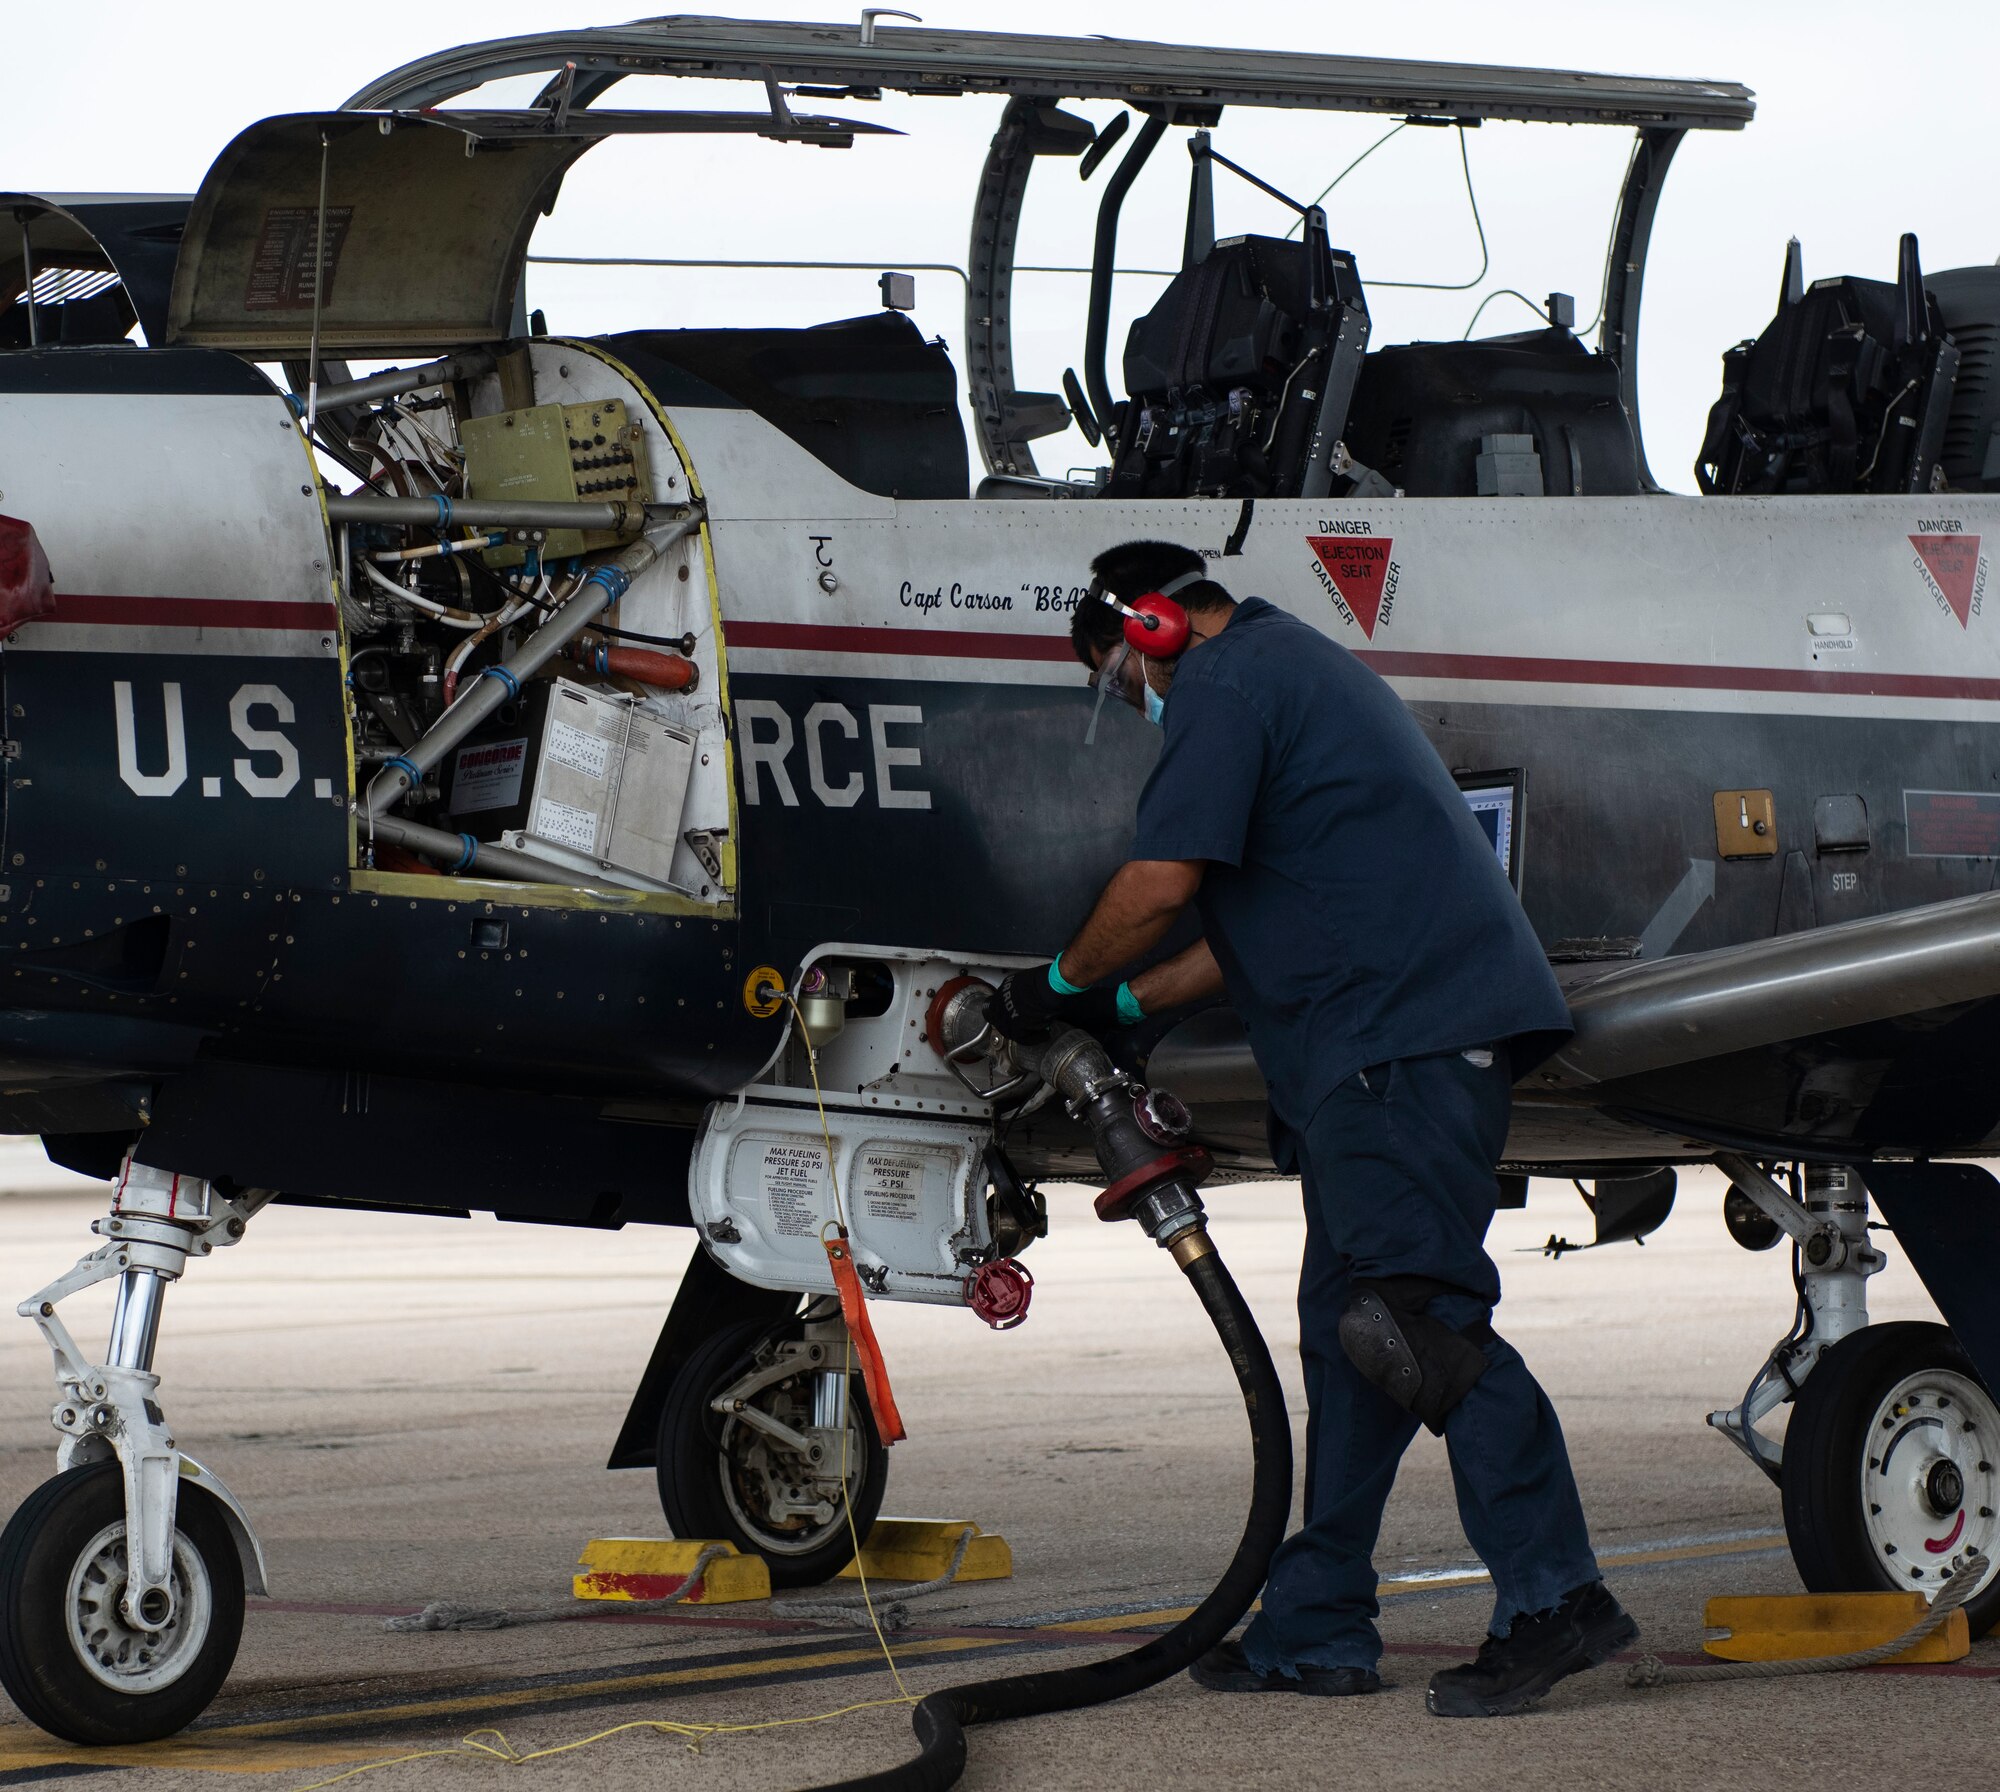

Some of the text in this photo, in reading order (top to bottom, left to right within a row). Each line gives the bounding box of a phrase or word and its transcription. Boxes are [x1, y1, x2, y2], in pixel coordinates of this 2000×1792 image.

[313, 208, 352, 216] WRNING
[1318, 520, 1372, 535] DANGER
[1917, 519, 1963, 533] DANGER
[1321, 545, 1384, 561] EJECTION
[1340, 563, 1373, 578] SEAT
[1311, 559, 1355, 626] DANGER
[1378, 561, 1401, 626] DANGER
[1912, 557, 1952, 617] DANGER
[1971, 556, 1989, 617] DANGER
[900, 581, 943, 615] Capt
[950, 582, 1013, 611] Carson
[1813, 639, 1854, 650] HANDHOLD
[113, 680, 332, 799] U.S.
[459, 745, 523, 769] CONCORDE
[734, 699, 932, 810] RCE
[1832, 873, 1857, 892] STEP
[769, 1147, 822, 1160] MAX FUELING
[764, 1156, 823, 1170] PRESSURE 50 PSI
[867, 1157, 920, 1169] MAX DEFUELING
[776, 1167, 808, 1178] JET FUEL
[873, 1168, 911, 1178] PRESSURE
[890, 1180, 904, 1188] PSI
[889, 1192, 916, 1200] PROCEDURE
